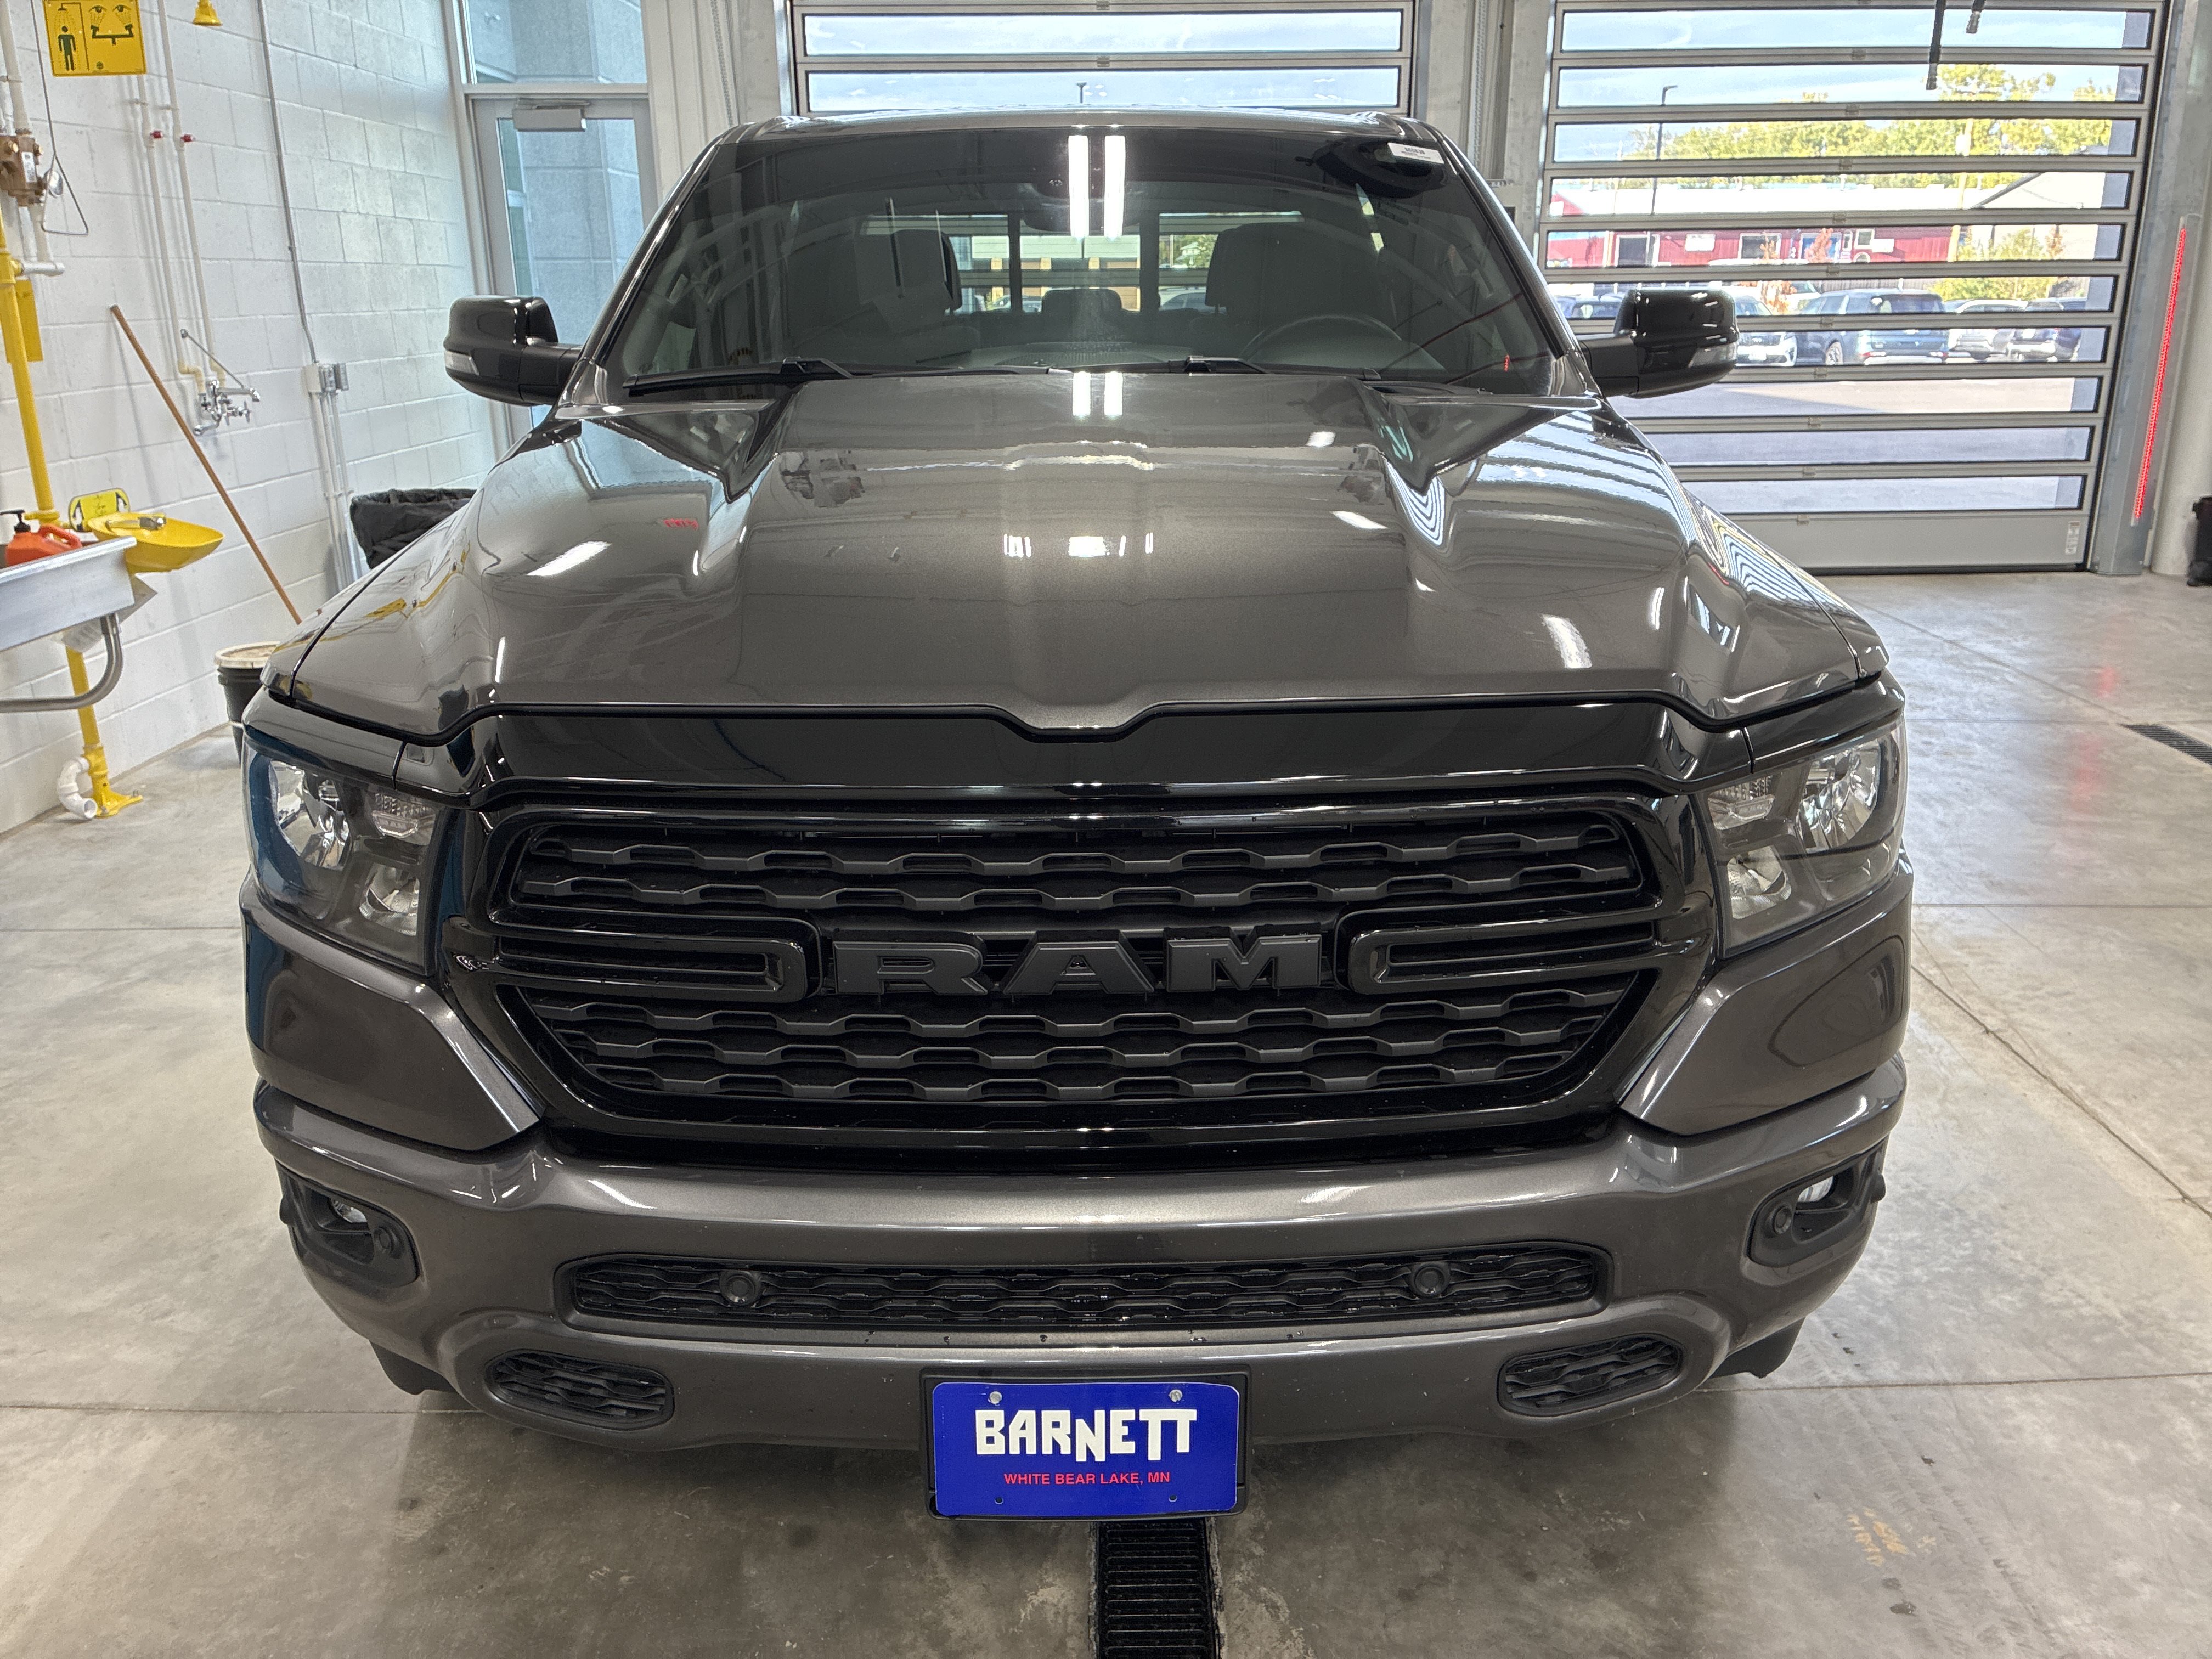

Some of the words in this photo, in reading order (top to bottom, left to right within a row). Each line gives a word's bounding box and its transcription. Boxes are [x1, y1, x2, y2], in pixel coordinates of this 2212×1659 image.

[833, 930, 1322, 995] RAM
[975, 1408, 1197, 1462] BARNETT
[1004, 1473, 1050, 1485] WHITE
[1055, 1473, 1096, 1485] BEAR
[1101, 1472, 1143, 1485] LAKE,
[1148, 1472, 1170, 1483] MN
